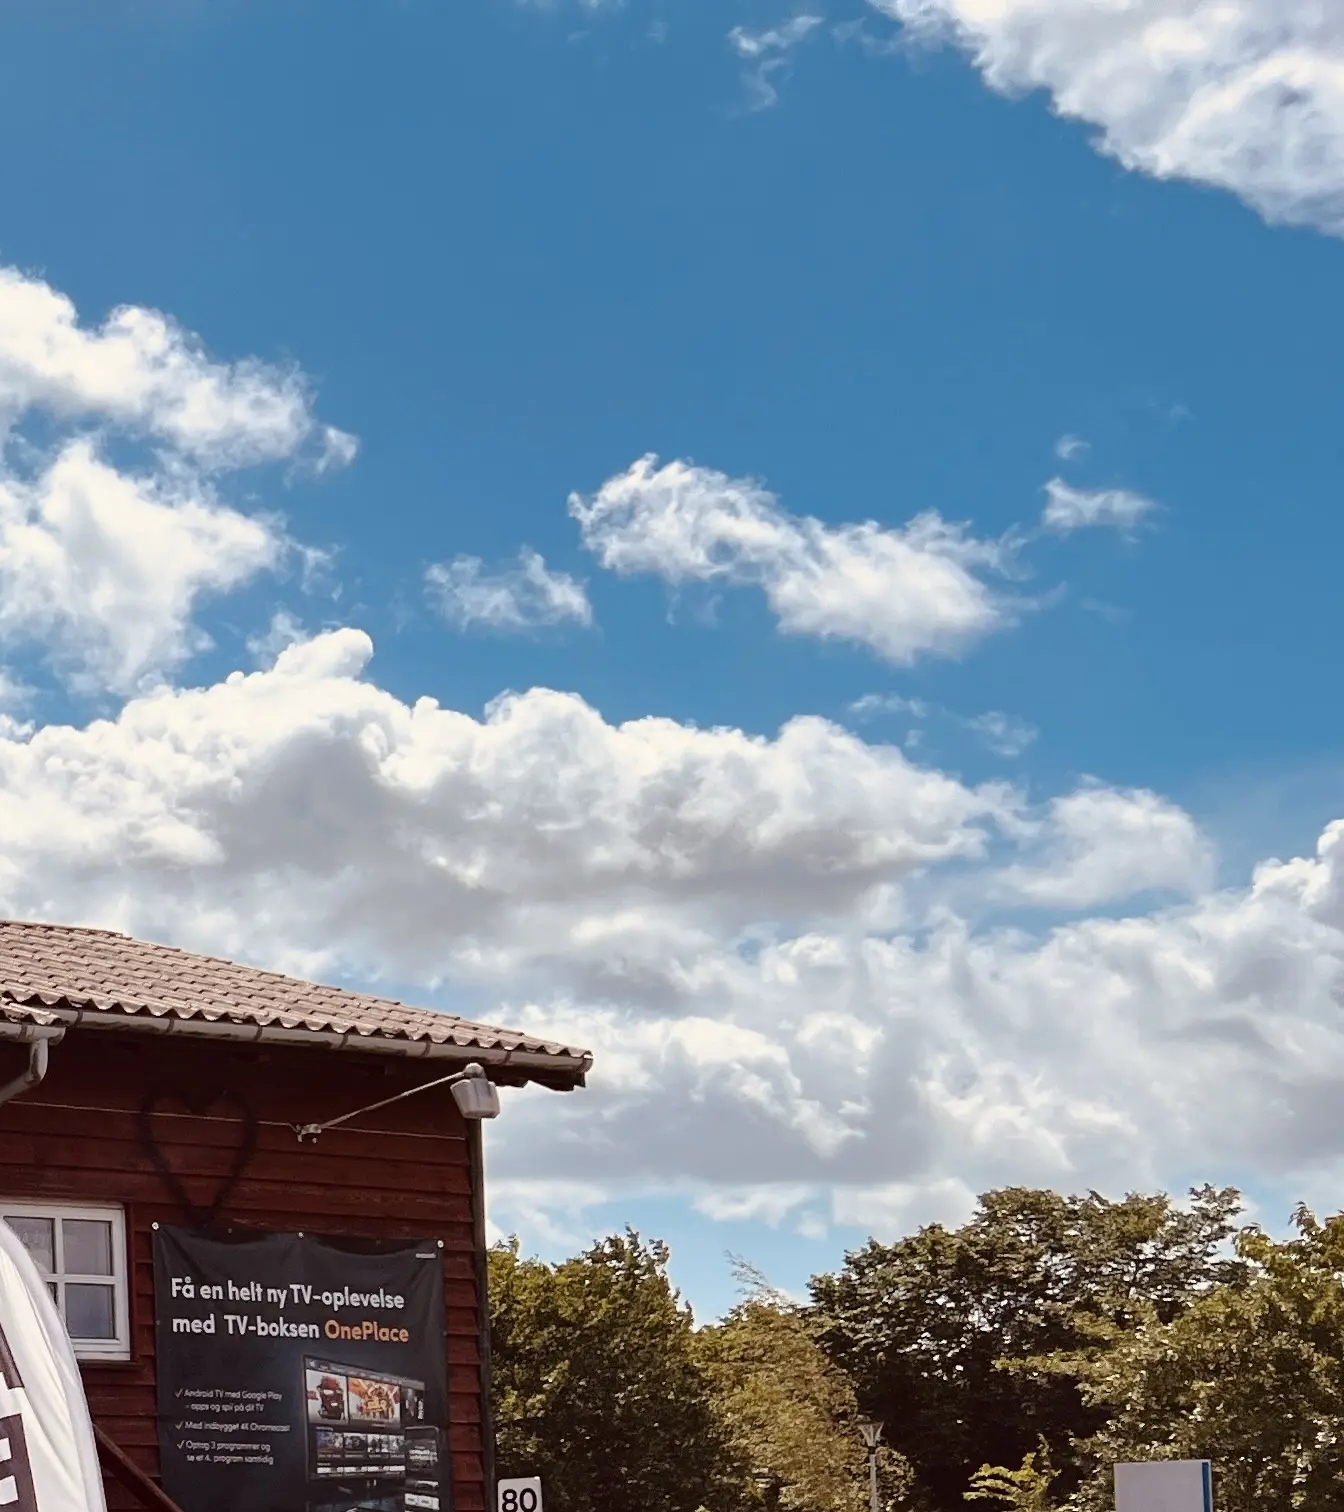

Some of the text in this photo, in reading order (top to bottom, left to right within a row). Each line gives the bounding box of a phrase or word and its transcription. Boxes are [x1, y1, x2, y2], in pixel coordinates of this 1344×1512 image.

[171, 1275, 405, 1311] Få en helt ny TV-oplevelse
[172, 1313, 410, 1343] med TV-boksen OnePlace
[183, 1388, 283, 1401] Android TV med Google Play
[210, 1403, 221, 1413] og
[255, 1403, 265, 1412] TV
[260, 1443, 272, 1453] og
